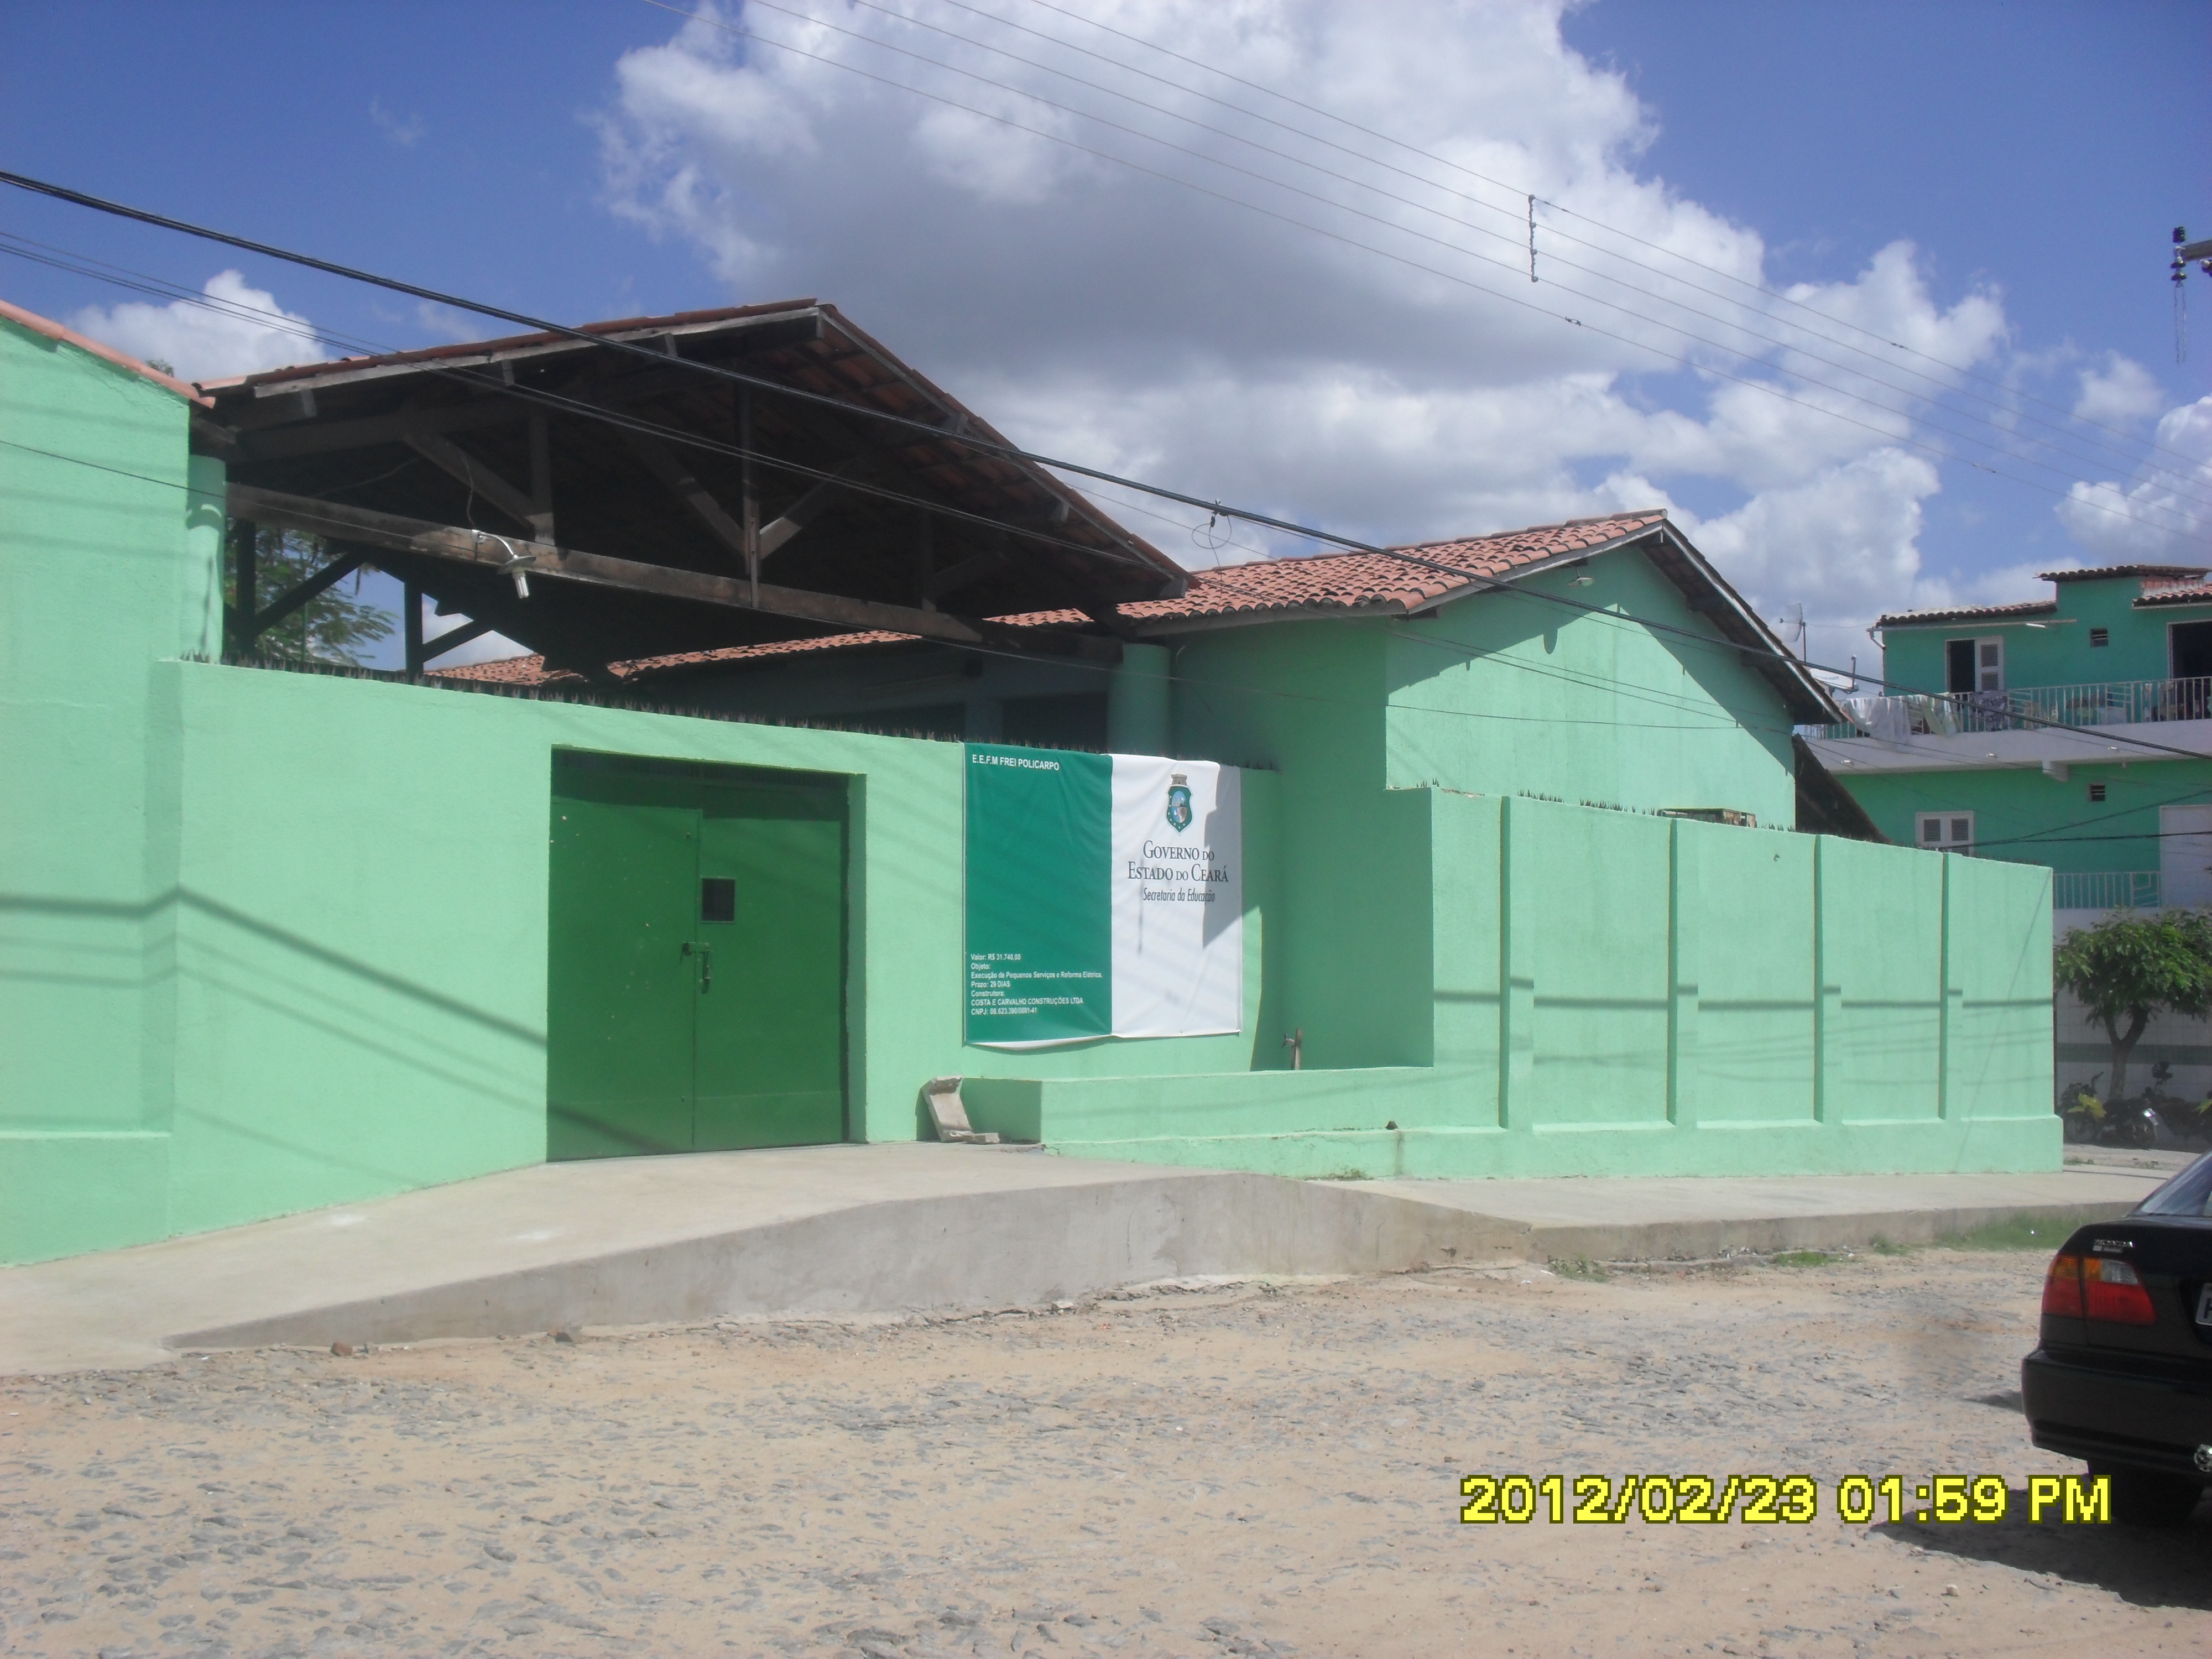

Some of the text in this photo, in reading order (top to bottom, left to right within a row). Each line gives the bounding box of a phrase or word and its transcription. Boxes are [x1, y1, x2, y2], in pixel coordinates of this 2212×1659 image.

[972, 754, 1060, 771] E.E.F.M FREI POLICARPO
[1143, 840, 1199, 860] GOVERNO
[1128, 861, 1173, 880] ESTADO
[1191, 863, 1229, 882] CEARÁ
[1143, 887, 1215, 902] Secretaria da Educação
[971, 962, 991, 971] Objeto:
[971, 972, 998, 980] Execução
[1006, 971, 1032, 979] Pequenos
[1033, 971, 1056, 979] Serviços
[1027, 997, 1070, 1005] CONSTRUÇÕES
